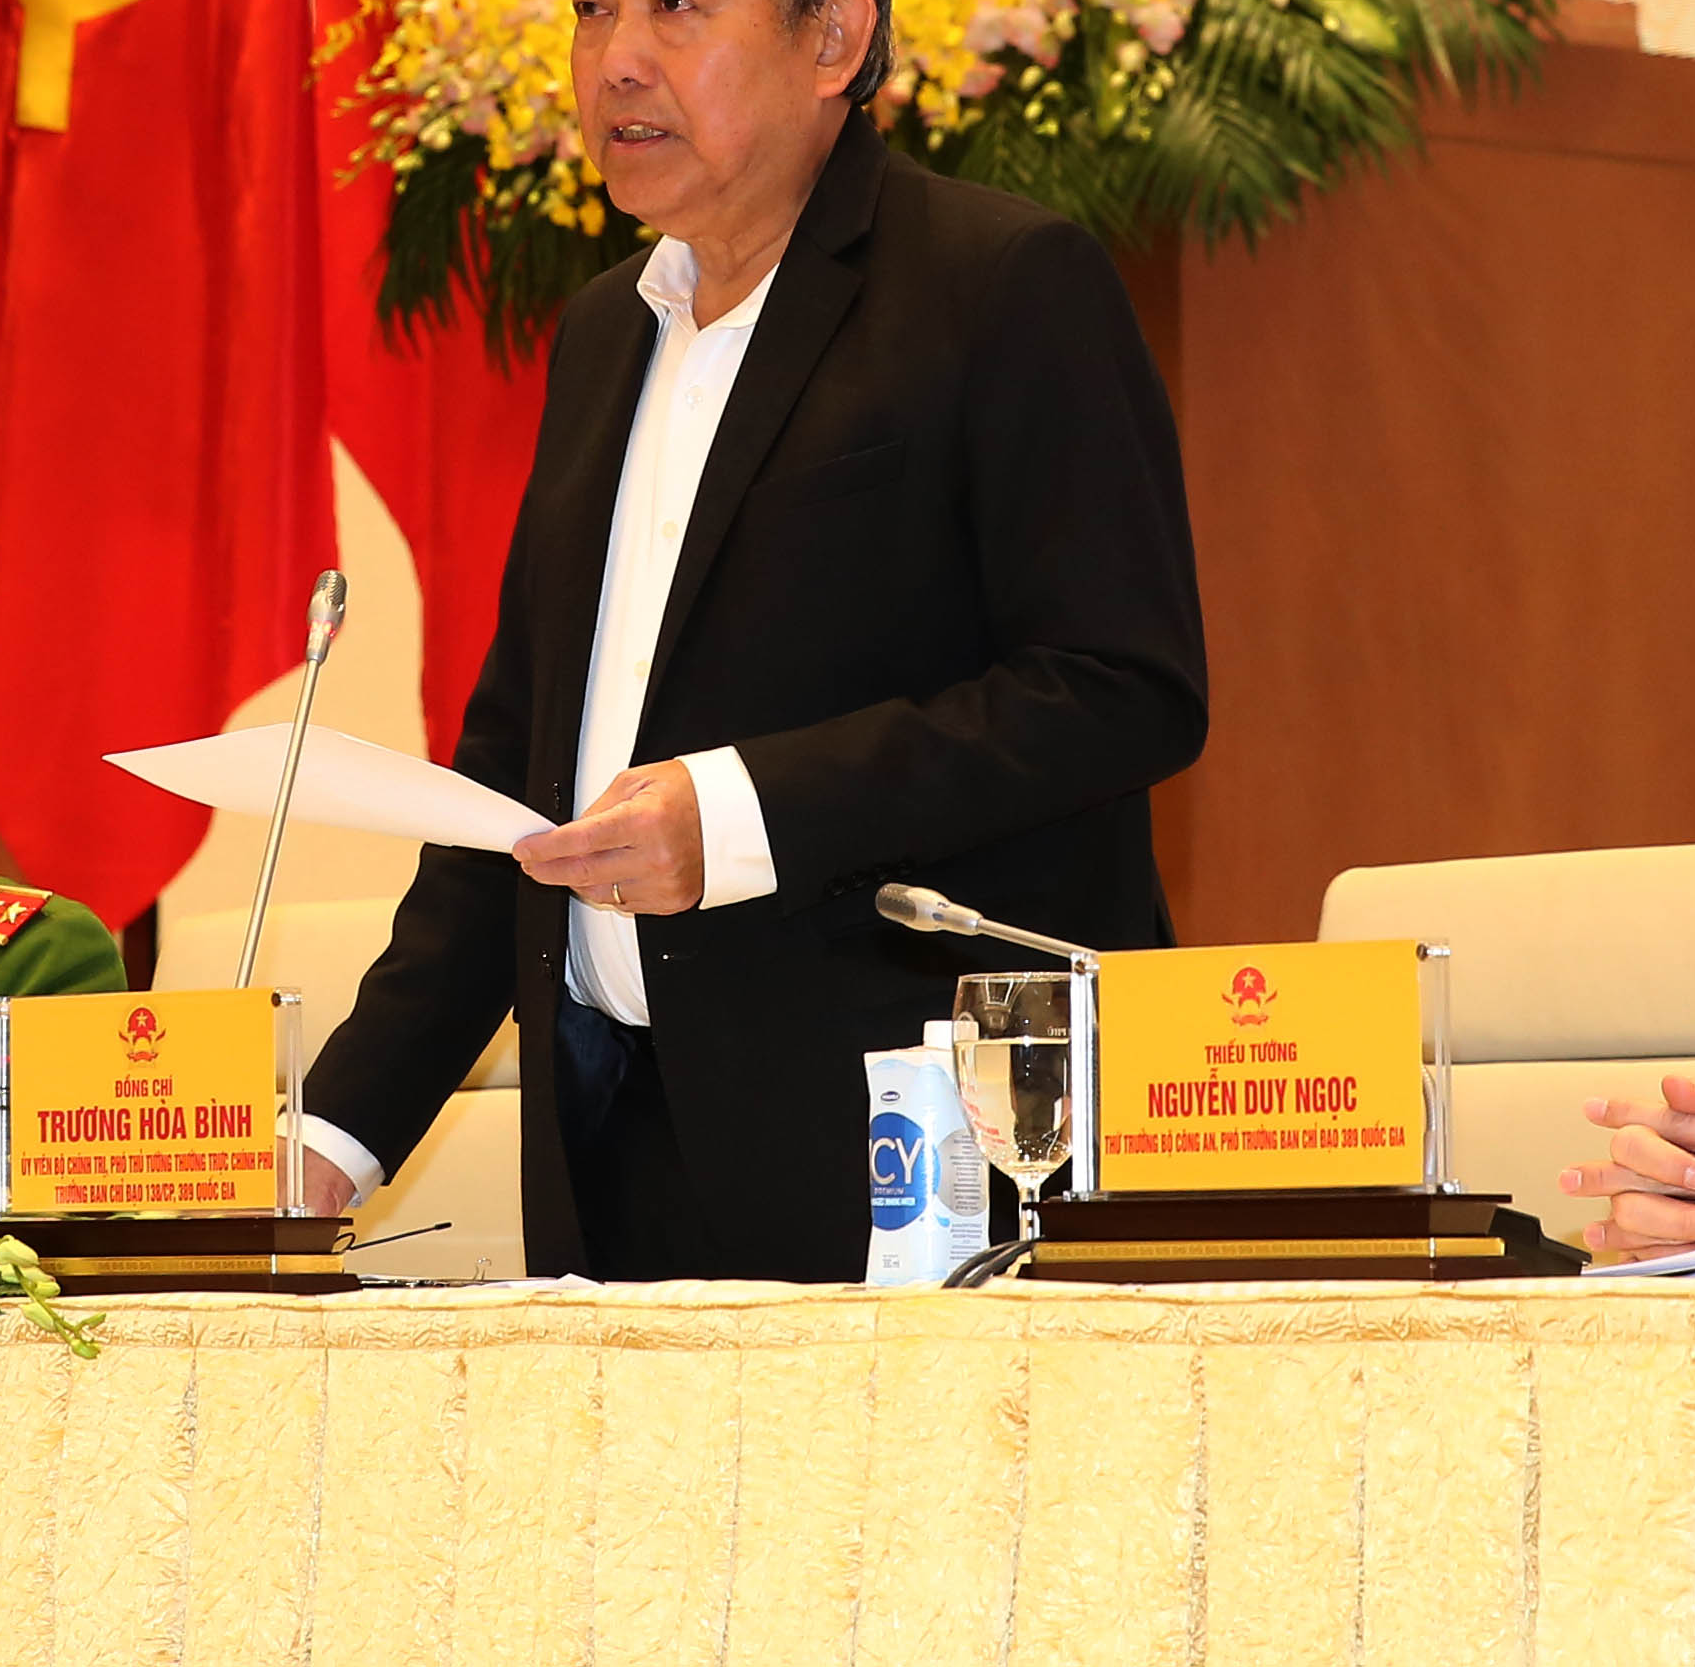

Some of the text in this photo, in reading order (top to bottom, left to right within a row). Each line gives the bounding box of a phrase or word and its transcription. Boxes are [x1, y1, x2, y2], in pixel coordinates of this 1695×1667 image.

[1205, 1038, 1297, 1064] THIẾU TƯỚNG
[152, 1075, 173, 1096] CHÍ
[1148, 1068, 1357, 1120] NGUYỄN DUY NGỌC
[38, 1098, 252, 1143] TRƯƠNG HÒA BÌNH
[870, 1137, 924, 1185] CY
